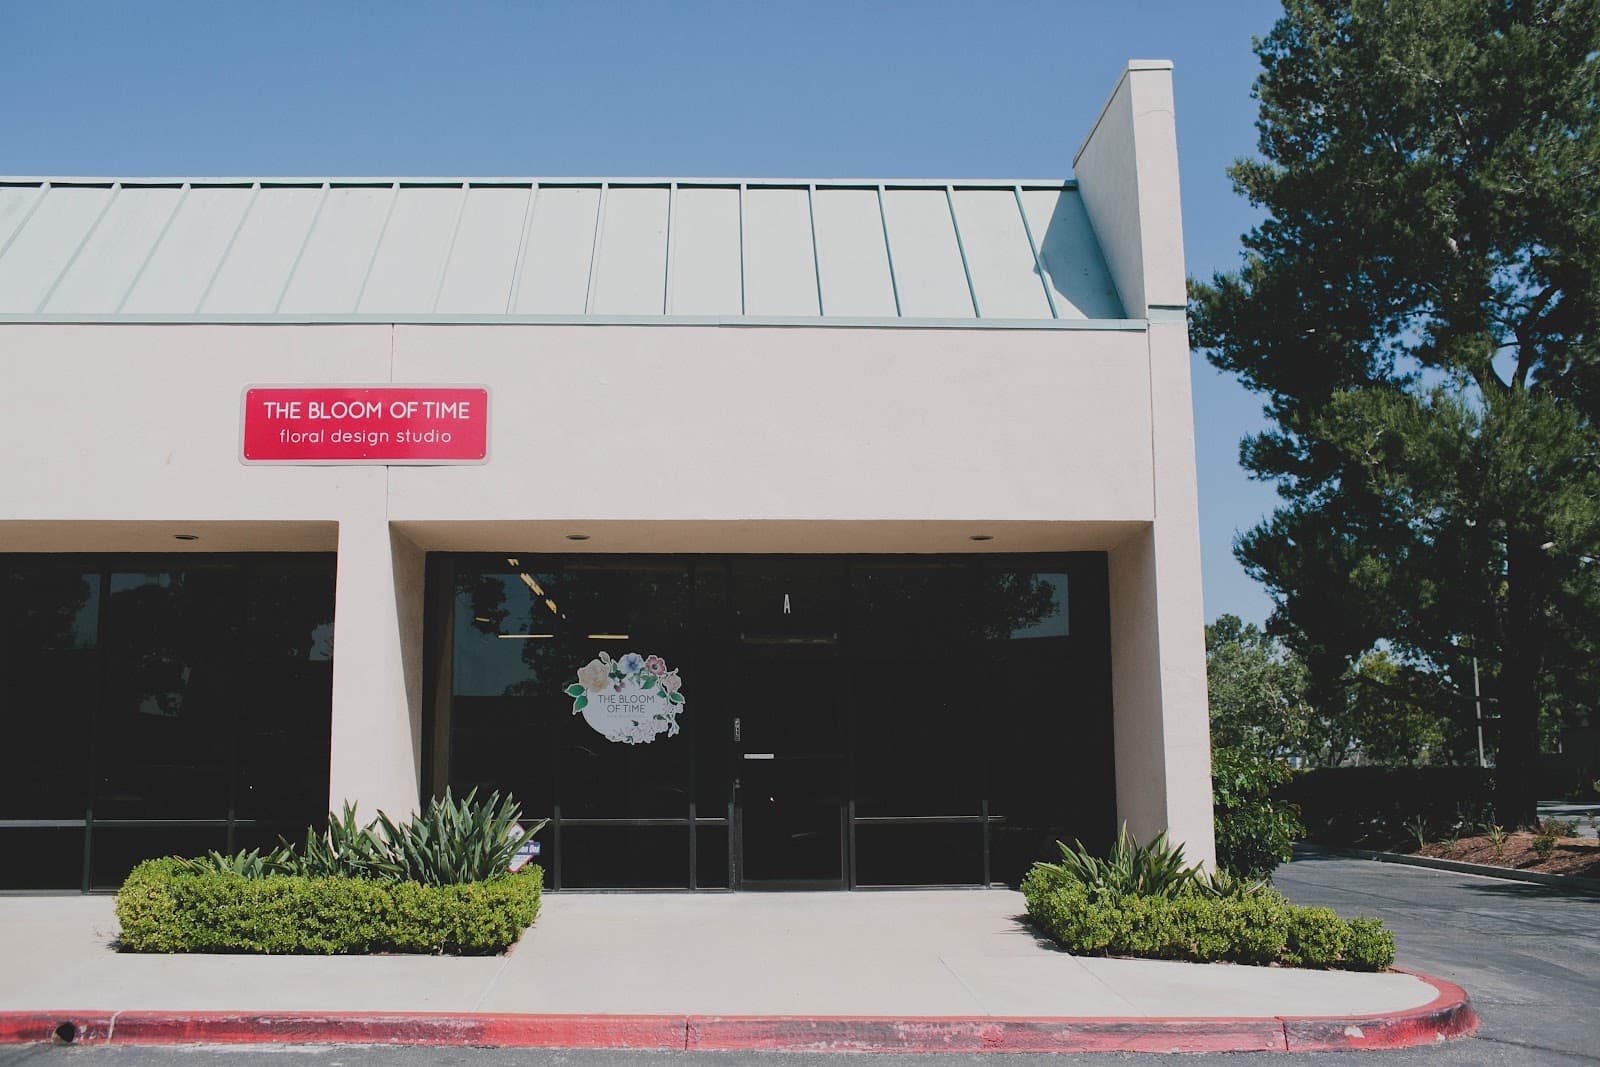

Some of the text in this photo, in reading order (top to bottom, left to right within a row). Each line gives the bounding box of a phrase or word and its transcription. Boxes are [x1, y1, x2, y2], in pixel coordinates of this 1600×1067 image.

[264, 401, 470, 419] THE BLOOM OF TIME
[279, 428, 452, 446] floral design studio
[783, 593, 791, 614] A
[598, 694, 655, 704] THE BLOOM
[606, 704, 646, 713] OF TIME
